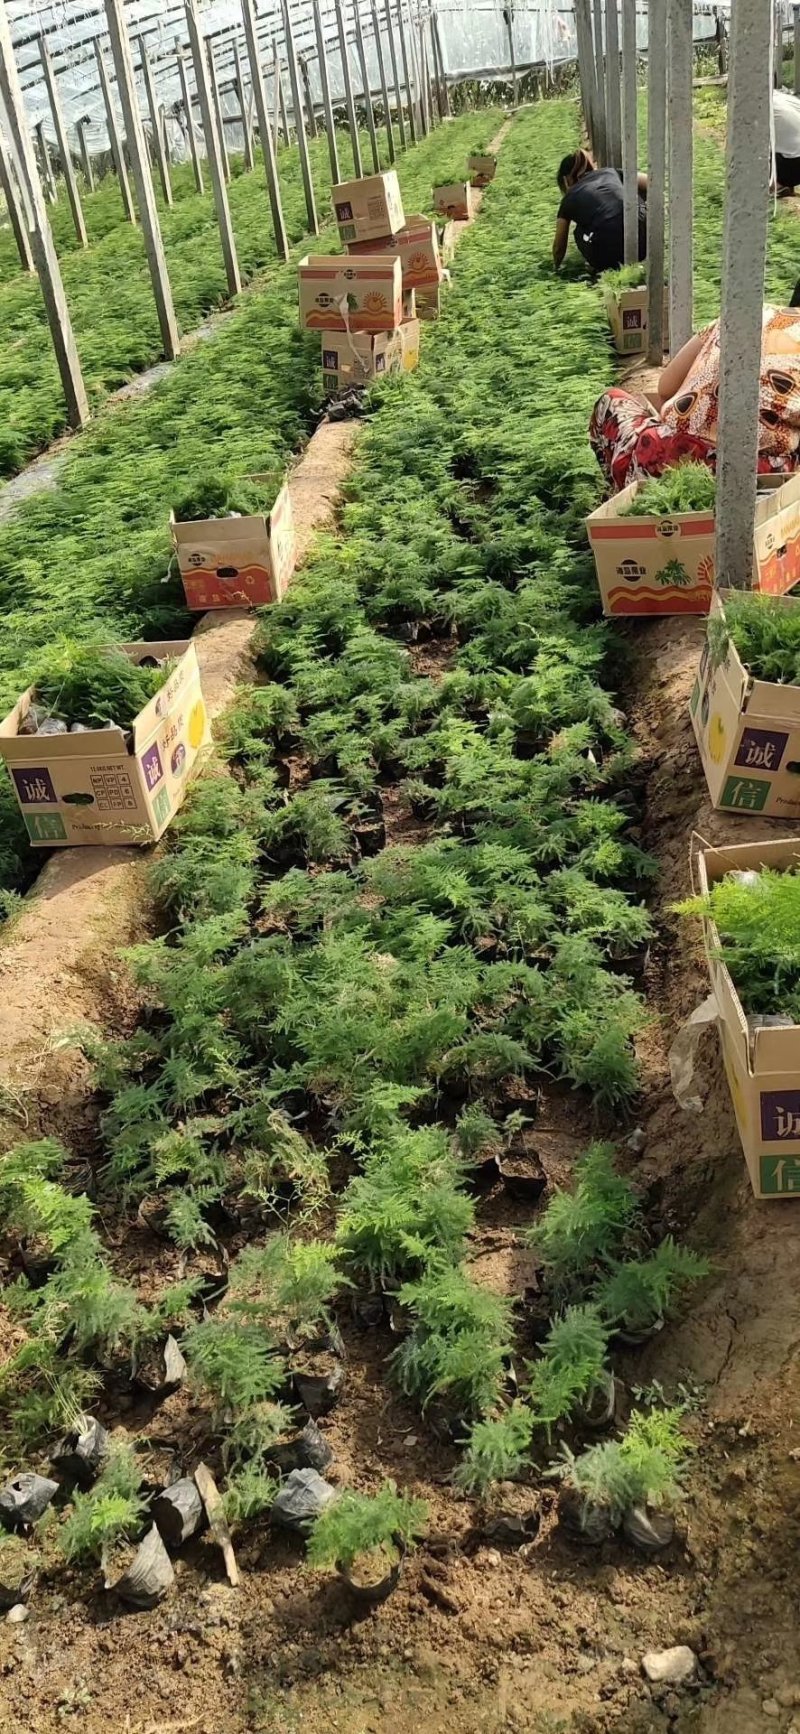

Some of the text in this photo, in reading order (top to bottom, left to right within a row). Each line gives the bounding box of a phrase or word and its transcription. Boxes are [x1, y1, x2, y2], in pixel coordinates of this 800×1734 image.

[745, 740, 777, 768] 诚
[146, 756, 162, 786] 诚
[22, 777, 50, 801] 诚
[731, 781, 762, 808] 信
[33, 816, 60, 840] 信
